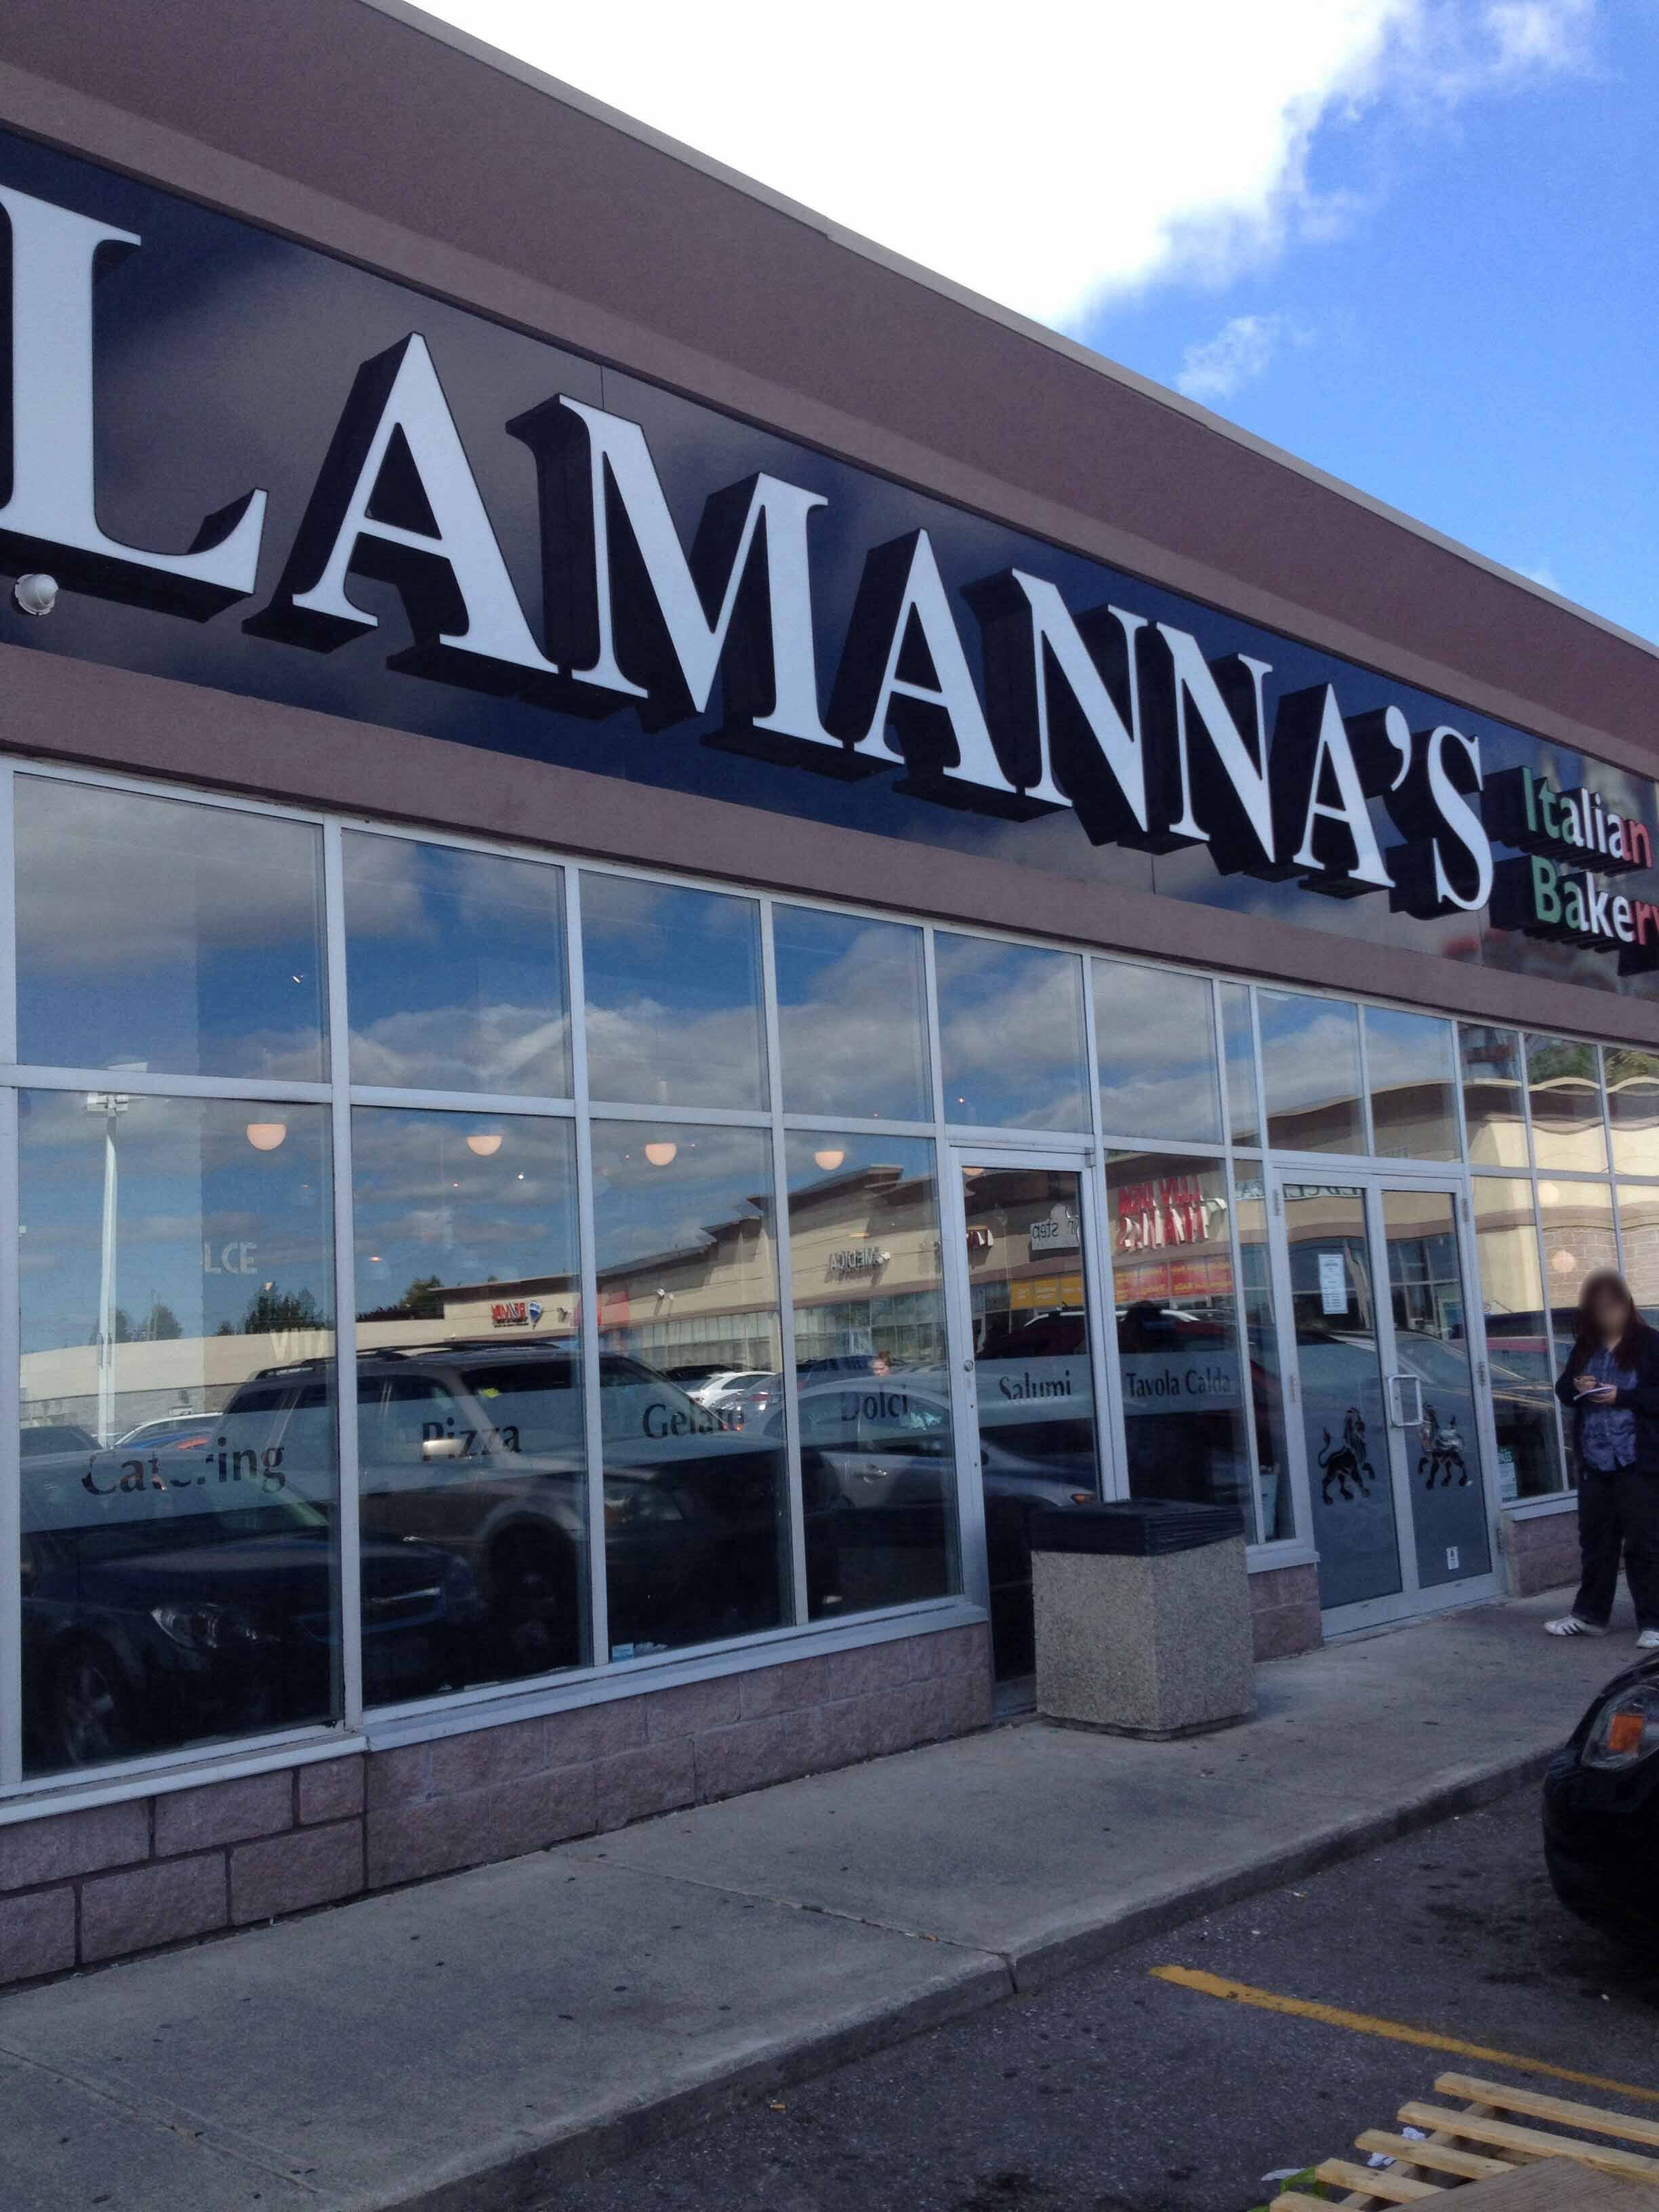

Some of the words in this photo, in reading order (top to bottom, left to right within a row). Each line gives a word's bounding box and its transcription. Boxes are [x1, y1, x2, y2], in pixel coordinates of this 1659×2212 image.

[0, 184, 1494, 912] LAMANNA'S
[1522, 766, 1654, 868] Italian
[840, 1382, 909, 1422] Dolci
[999, 1370, 1072, 1400] Salumi
[1126, 1370, 1182, 1397] Tavola
[81, 1436, 286, 1496] Cating
